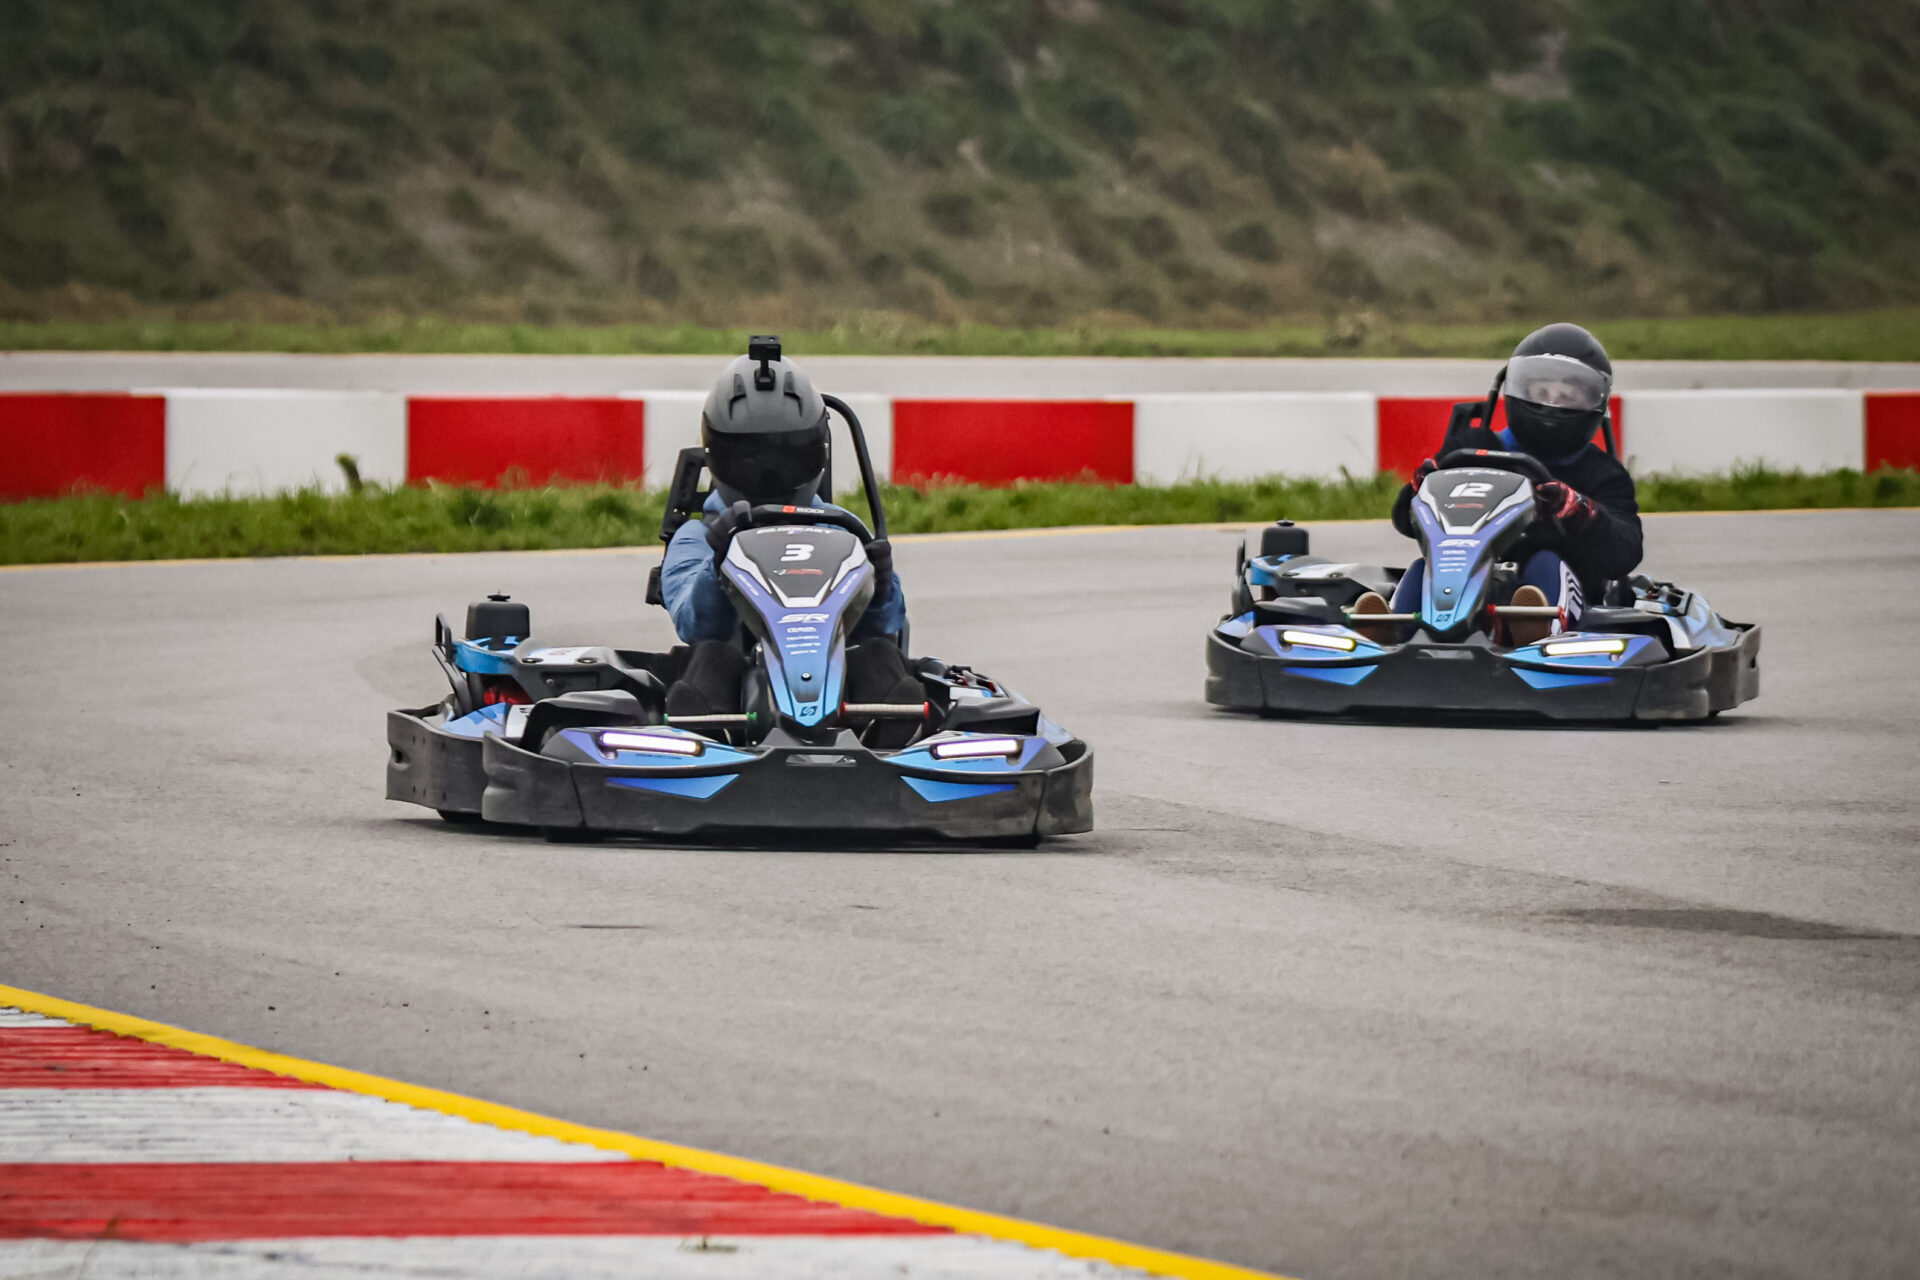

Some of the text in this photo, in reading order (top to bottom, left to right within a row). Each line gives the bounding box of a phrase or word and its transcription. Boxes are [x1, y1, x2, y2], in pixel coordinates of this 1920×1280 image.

[1449, 482, 1493, 497] 12
[780, 544, 815, 562] 3
[776, 613, 830, 624] SR
